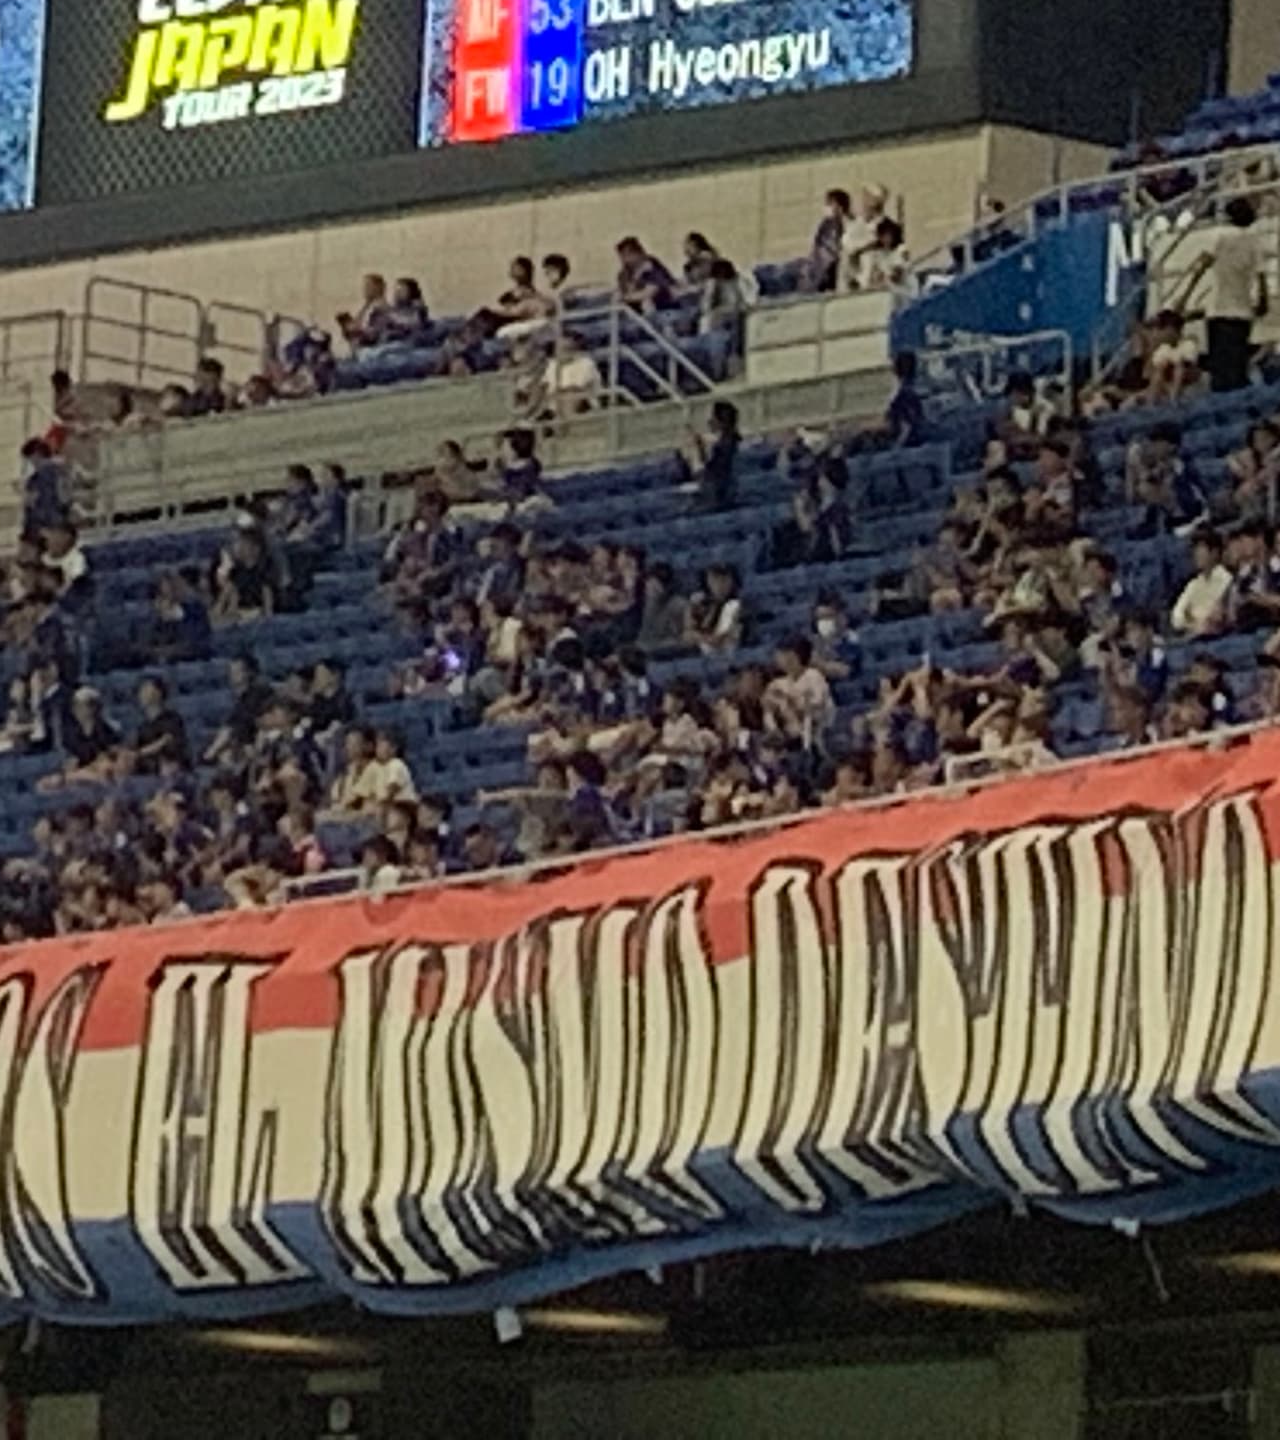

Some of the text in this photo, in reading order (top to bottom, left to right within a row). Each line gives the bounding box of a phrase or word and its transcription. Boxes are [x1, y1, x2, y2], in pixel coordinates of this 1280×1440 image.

[531, 57, 568, 107] 19
[584, 49, 629, 102] OH
[649, 29, 831, 98] Hyeongyu
[162, 80, 253, 130] TOUR
